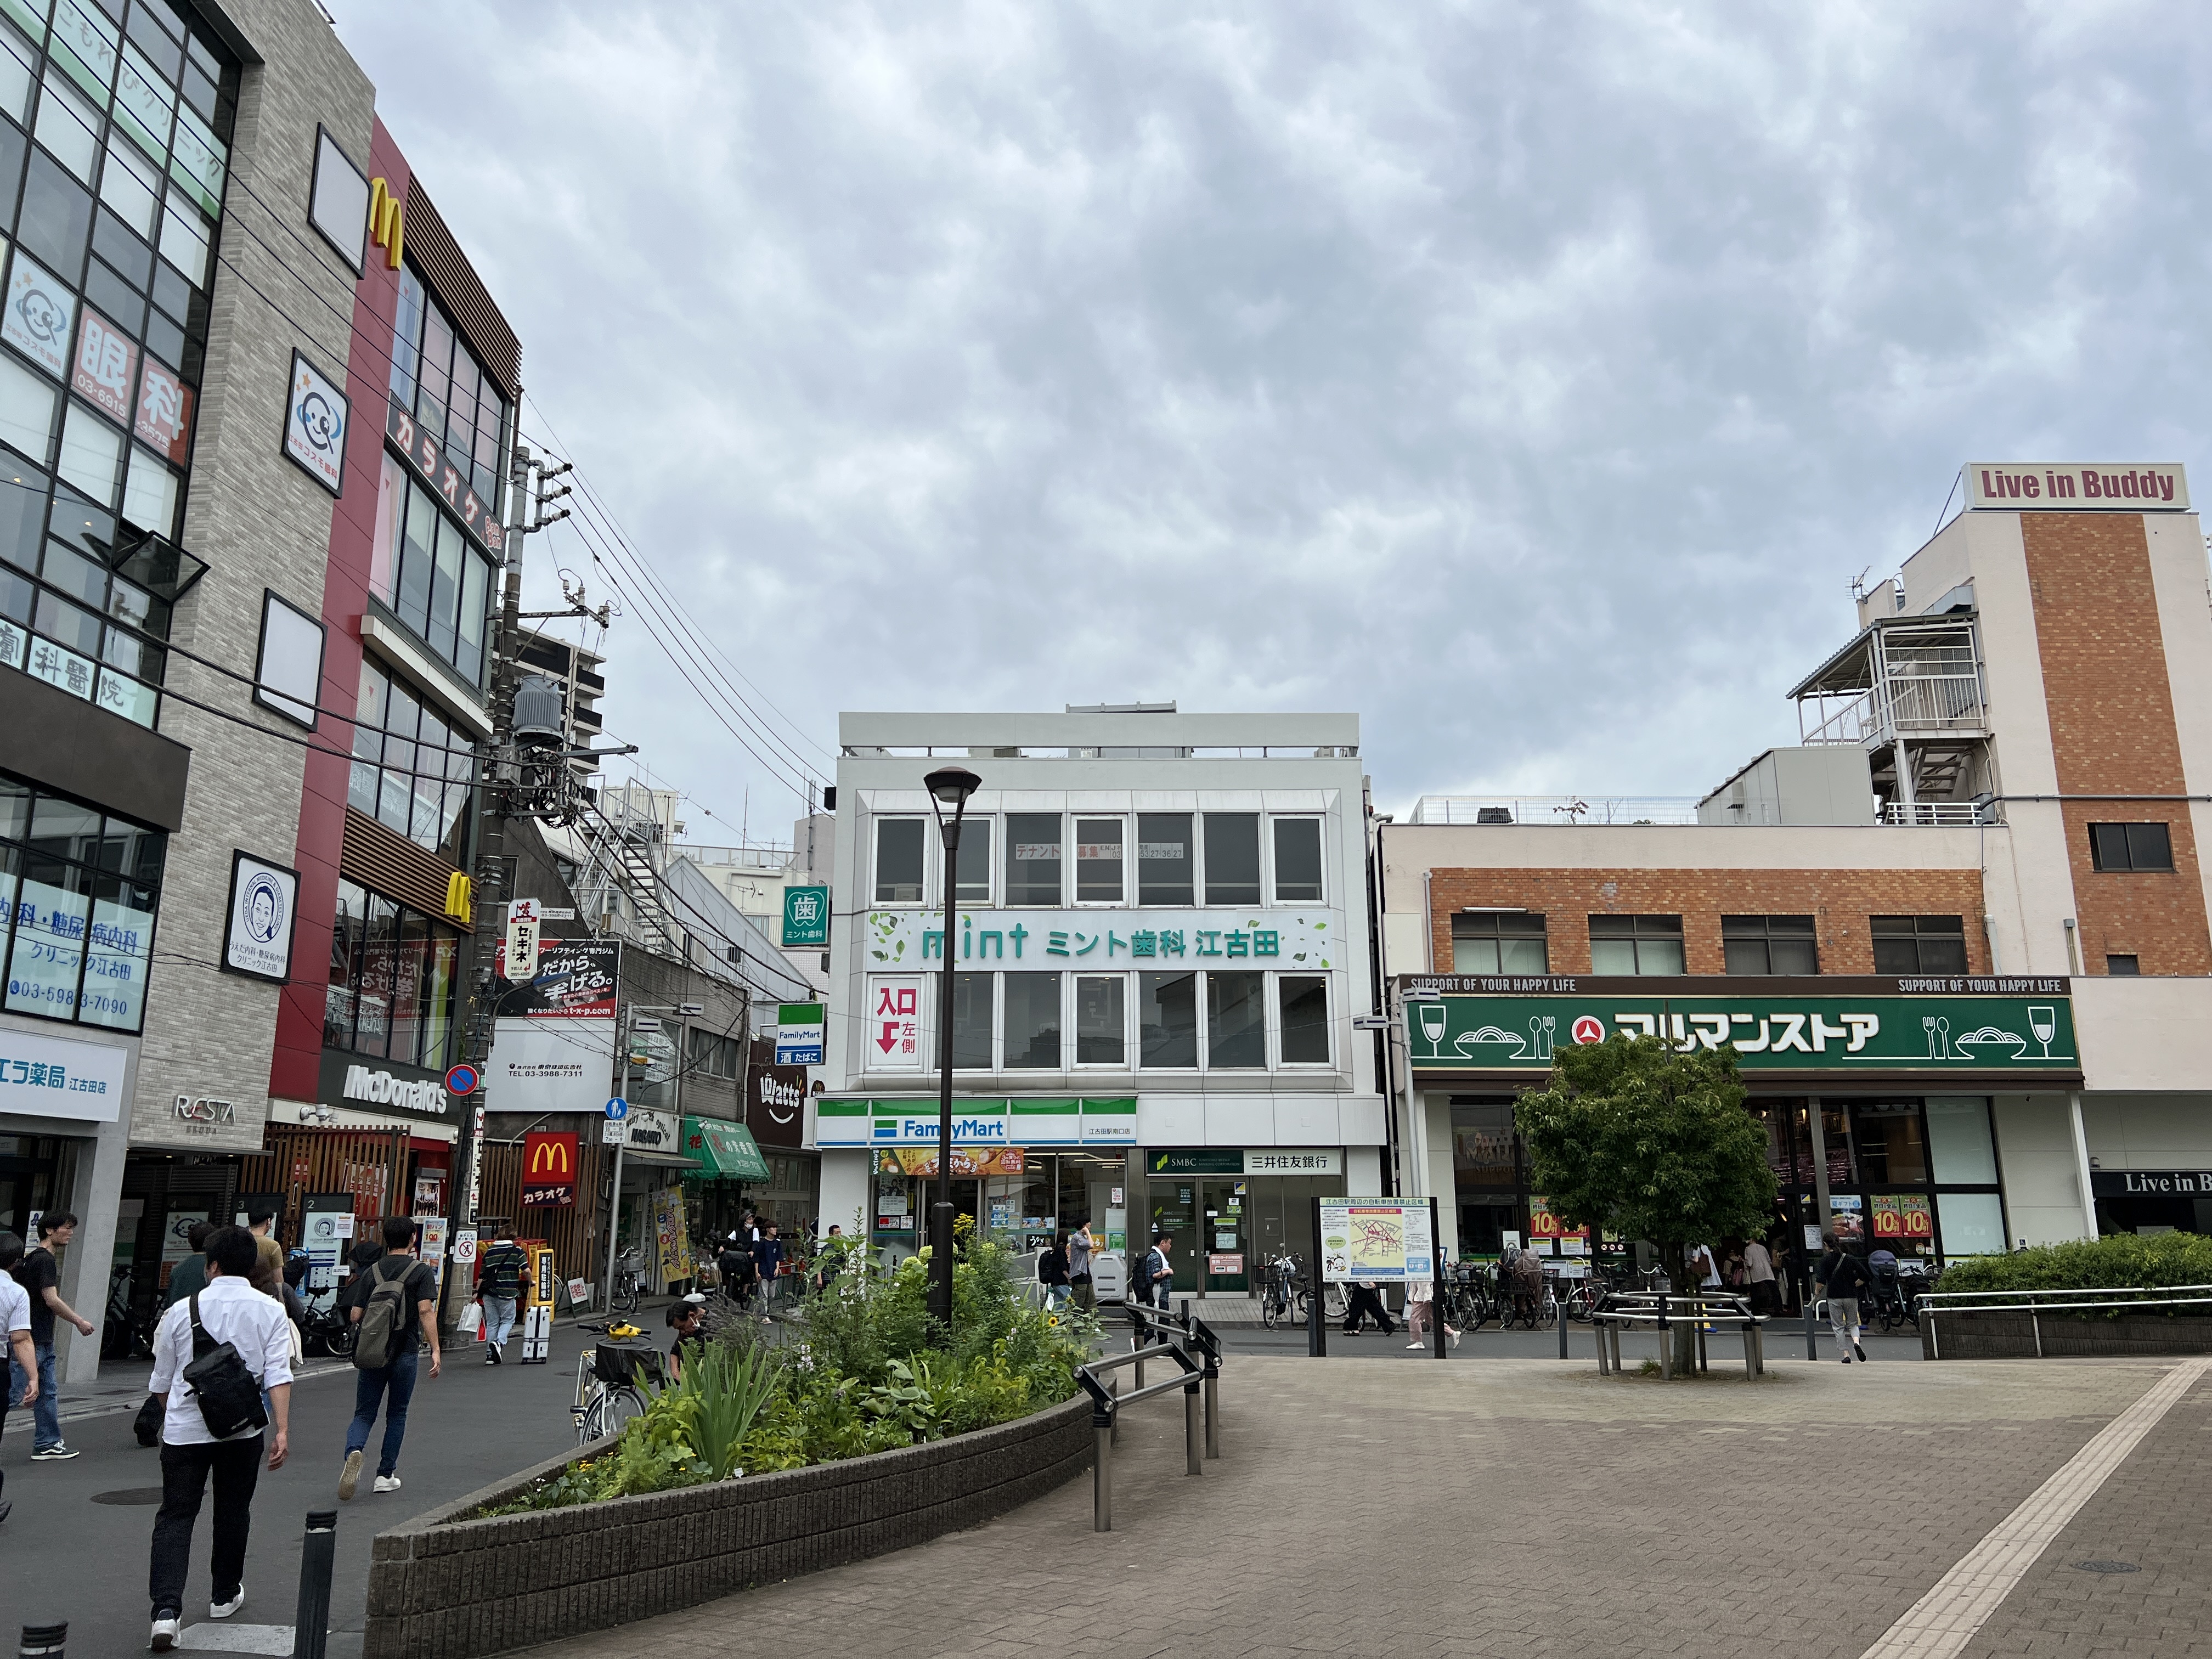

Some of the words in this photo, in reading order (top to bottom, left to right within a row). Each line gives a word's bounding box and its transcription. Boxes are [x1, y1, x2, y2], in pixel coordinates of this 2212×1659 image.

[396, 410, 479, 524] カラオケ
[1981, 470, 2040, 498] Live
[2046, 470, 2076, 498] in
[2080, 470, 2174, 501] Buddy
[1017, 845, 1060, 858] テナント
[1077, 845, 1098, 858] 募集
[794, 896, 818, 921] 歯
[786, 929, 823, 939] ミント歯科
[1046, 929, 1187, 958] ミント歯科
[1195, 928, 1280, 958] 江古田
[516, 926, 529, 963] セキネ
[1410, 978, 1459, 991] SUPPORT
[1463, 978, 1477, 991] OF
[1481, 979, 1510, 991] YOUR
[1514, 979, 1549, 991] HAPPY
[1553, 979, 1576, 992] LIFE
[1898, 979, 1946, 992] SUPPORT
[1950, 979, 1963, 992] OF
[1967, 980, 1996, 992] YOUR
[2000, 980, 2034, 992] HAPPY
[2038, 980, 2062, 992] LIFE
[877, 988, 916, 1017] 入口
[779, 1030, 820, 1041] FamilyMart
[901, 1021, 916, 1054] 左側
[1614, 1013, 1880, 1053] マルマンストア
[780, 1052, 792, 1063] 酒
[795, 1052, 818, 1063] たばこ
[69, 1077, 107, 1095] 江古田店
[343, 1065, 448, 1114] McDonald's
[760, 1073, 800, 1108] Watts
[905, 1120, 1003, 1139] FamyMart
[1171, 1158, 1197, 1166] SMBC
[1251, 1155, 1328, 1169] 三井住友銀行
[2124, 1173, 2170, 1192] Live
[2175, 1173, 2195, 1192] in
[308, 1200, 315, 1209] 2
[524, 1187, 566, 1204] カラオケ
